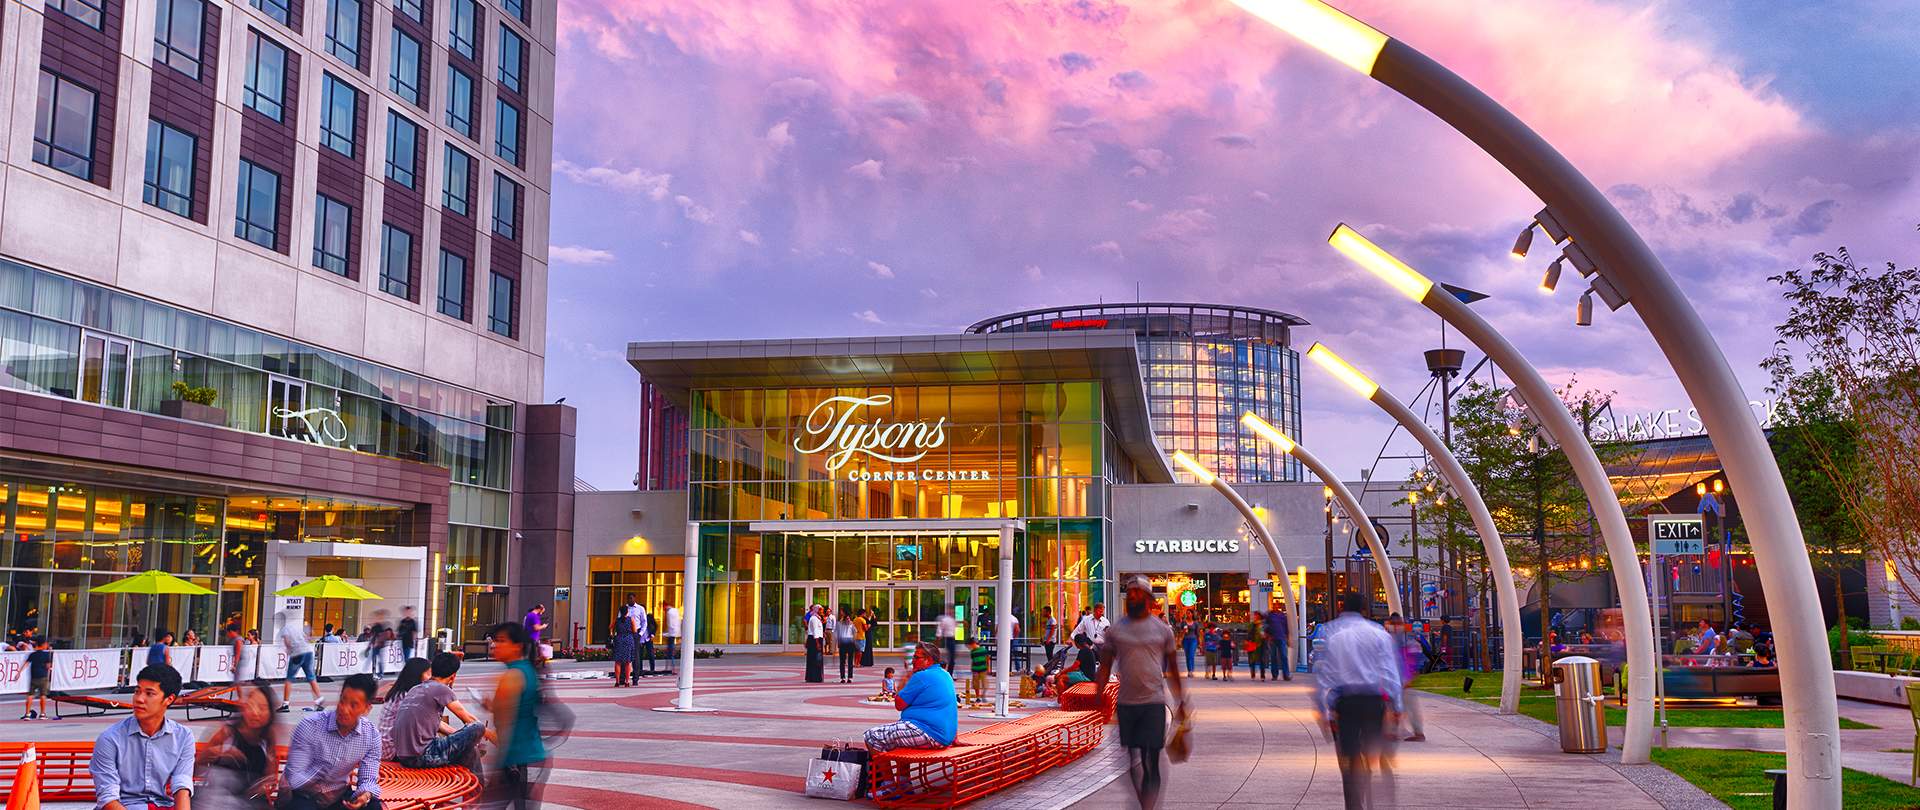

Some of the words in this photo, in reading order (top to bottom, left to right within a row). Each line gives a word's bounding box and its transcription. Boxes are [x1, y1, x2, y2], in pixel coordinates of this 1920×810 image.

[793, 394, 946, 471] Tysons
[1595, 409, 1682, 441] SHAKE
[1658, 523, 1691, 538] EXIT
[1135, 539, 1240, 553] STARBUCKS
